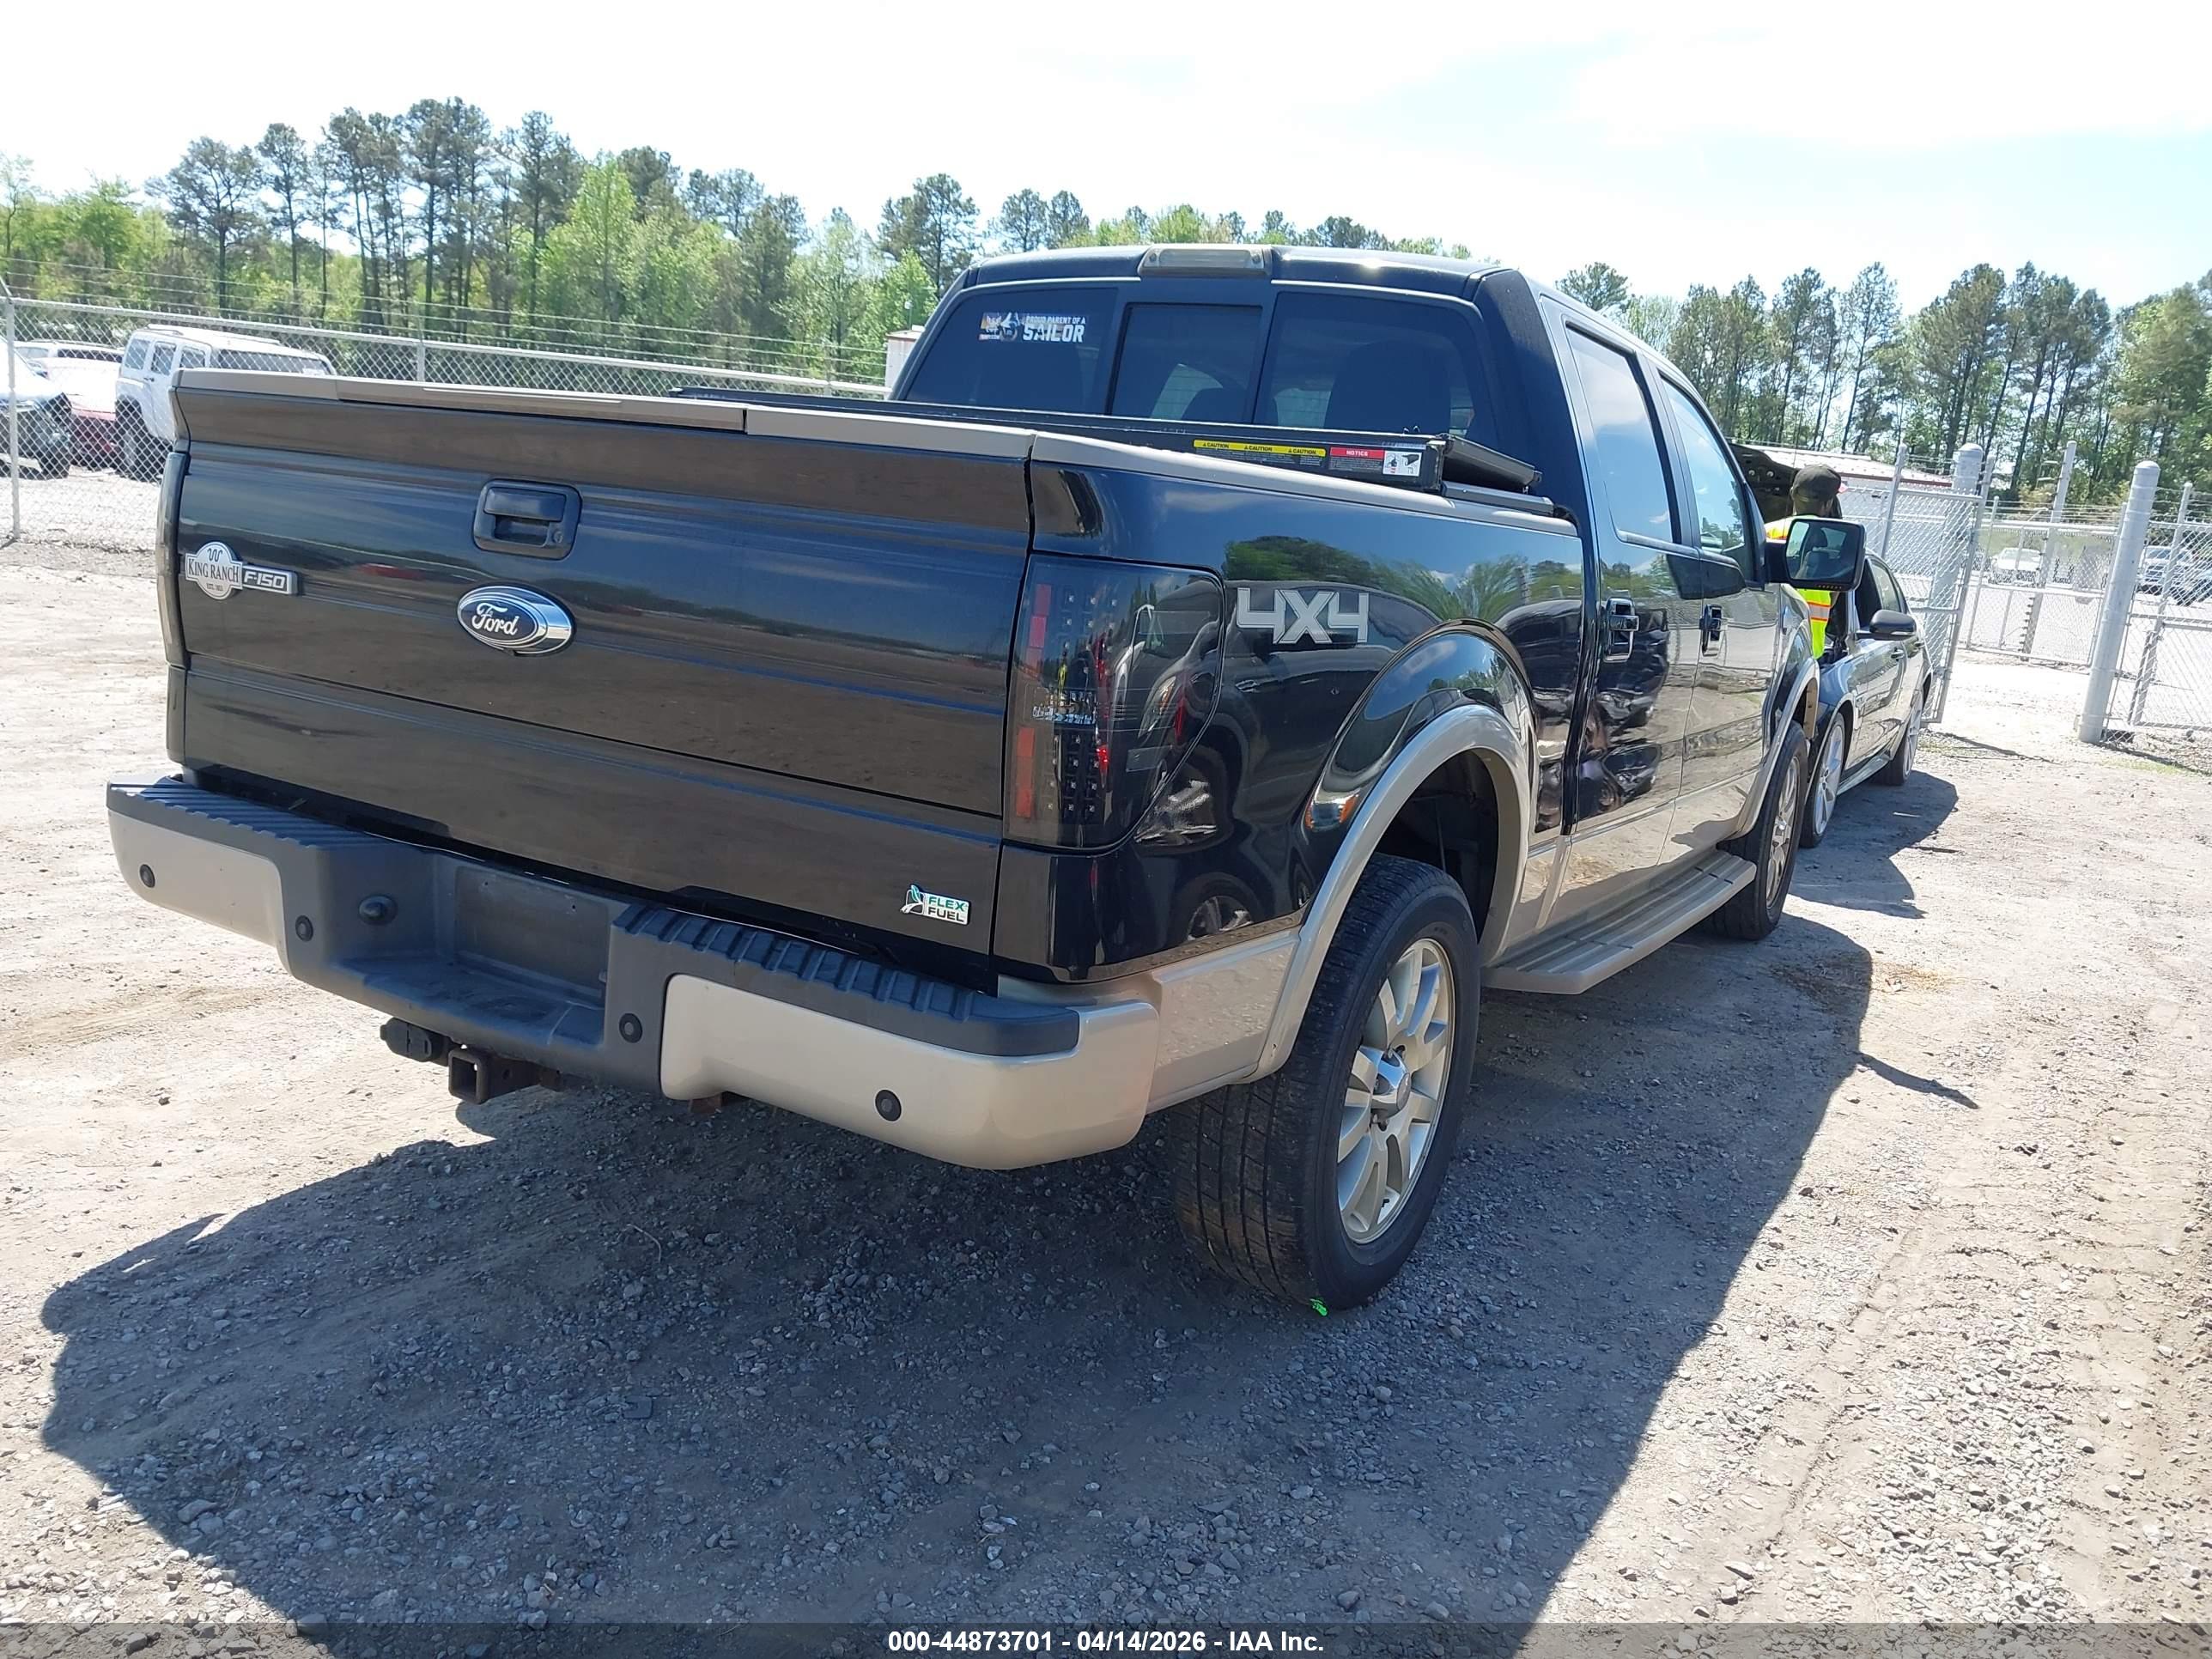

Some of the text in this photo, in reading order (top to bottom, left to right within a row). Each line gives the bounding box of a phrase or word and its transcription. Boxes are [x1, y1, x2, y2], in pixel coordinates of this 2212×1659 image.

[1023, 323, 1085, 343] SAILOR
[188, 558, 240, 583] KING RANCH
[244, 571, 286, 589] F-150
[471, 602, 520, 635] Ford
[928, 896, 966, 911] FLEX
[928, 907, 964, 922] FUEL
